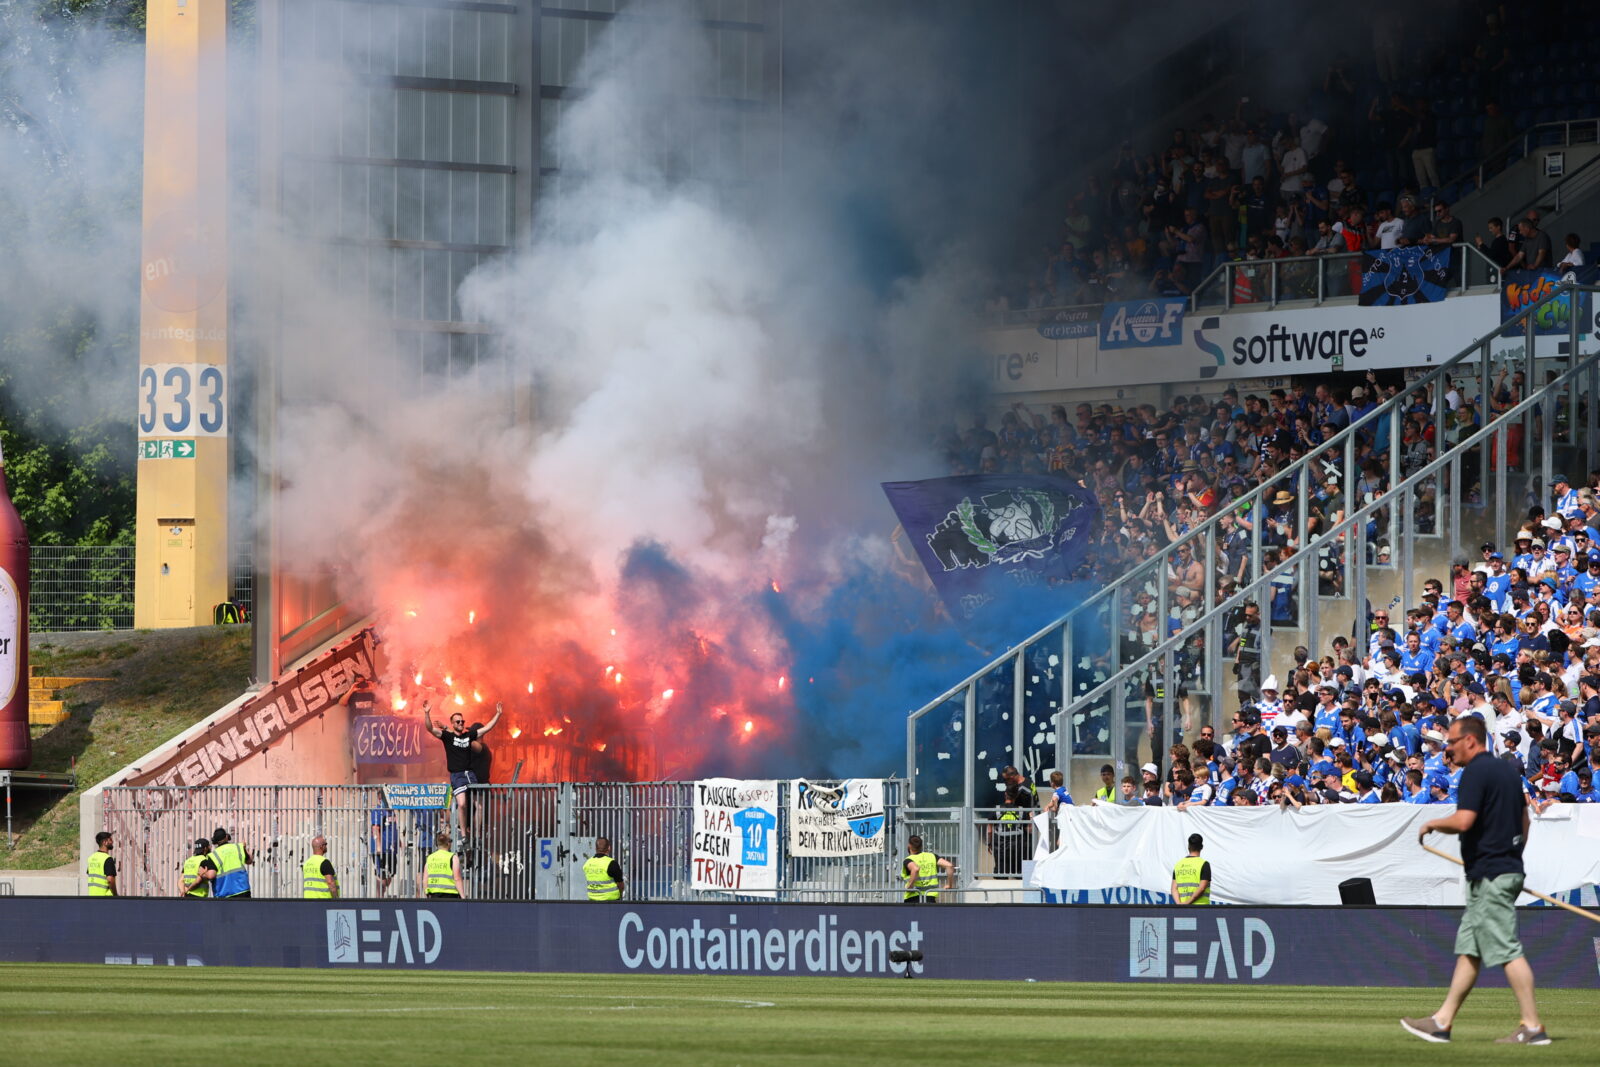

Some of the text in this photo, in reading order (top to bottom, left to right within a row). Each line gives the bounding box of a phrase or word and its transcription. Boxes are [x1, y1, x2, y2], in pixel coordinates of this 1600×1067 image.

[1506, 276, 1556, 312] Kids
[1232, 323, 1385, 365] software AG
[1025, 352, 1039, 364] AG
[139, 367, 224, 434] 333
[420, 785, 426, 795] &
[427, 785, 447, 795] WEED
[698, 785, 739, 809] TAUSCHE
[704, 809, 732, 833] PAPA
[858, 822, 870, 836] 07
[694, 832, 730, 857] GEGEN
[747, 823, 762, 849] 10
[798, 831, 818, 851] DEIN
[821, 829, 853, 852] TRIKOT
[540, 839, 552, 869] 5
[693, 857, 744, 889] TRIKOT
[618, 911, 924, 973] Containerdienst
